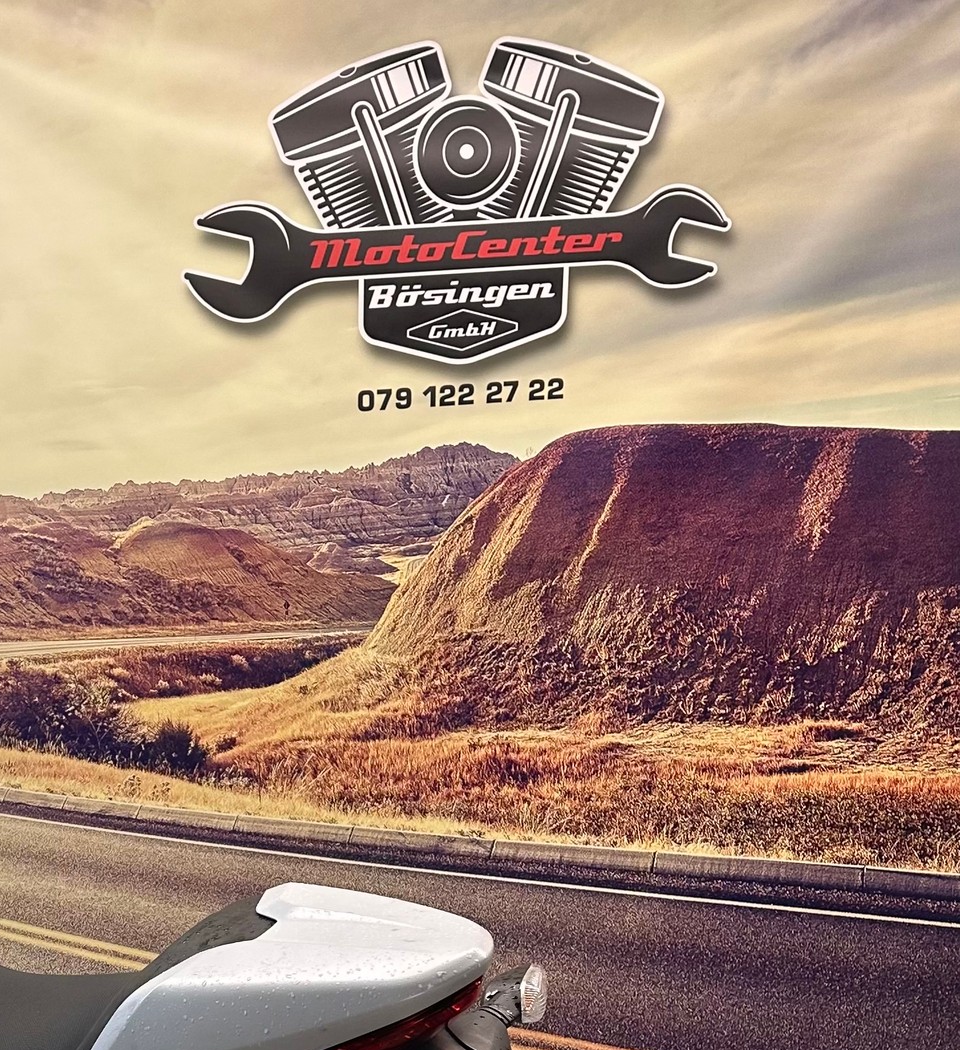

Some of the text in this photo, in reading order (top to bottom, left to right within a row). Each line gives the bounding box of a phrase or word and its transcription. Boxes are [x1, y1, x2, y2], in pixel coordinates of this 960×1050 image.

[309, 226, 623, 269] MotoCenter
[367, 279, 555, 310] Bösingen
[428, 319, 498, 341] GmbH
[357, 378, 565, 412] 079 122 27 22
